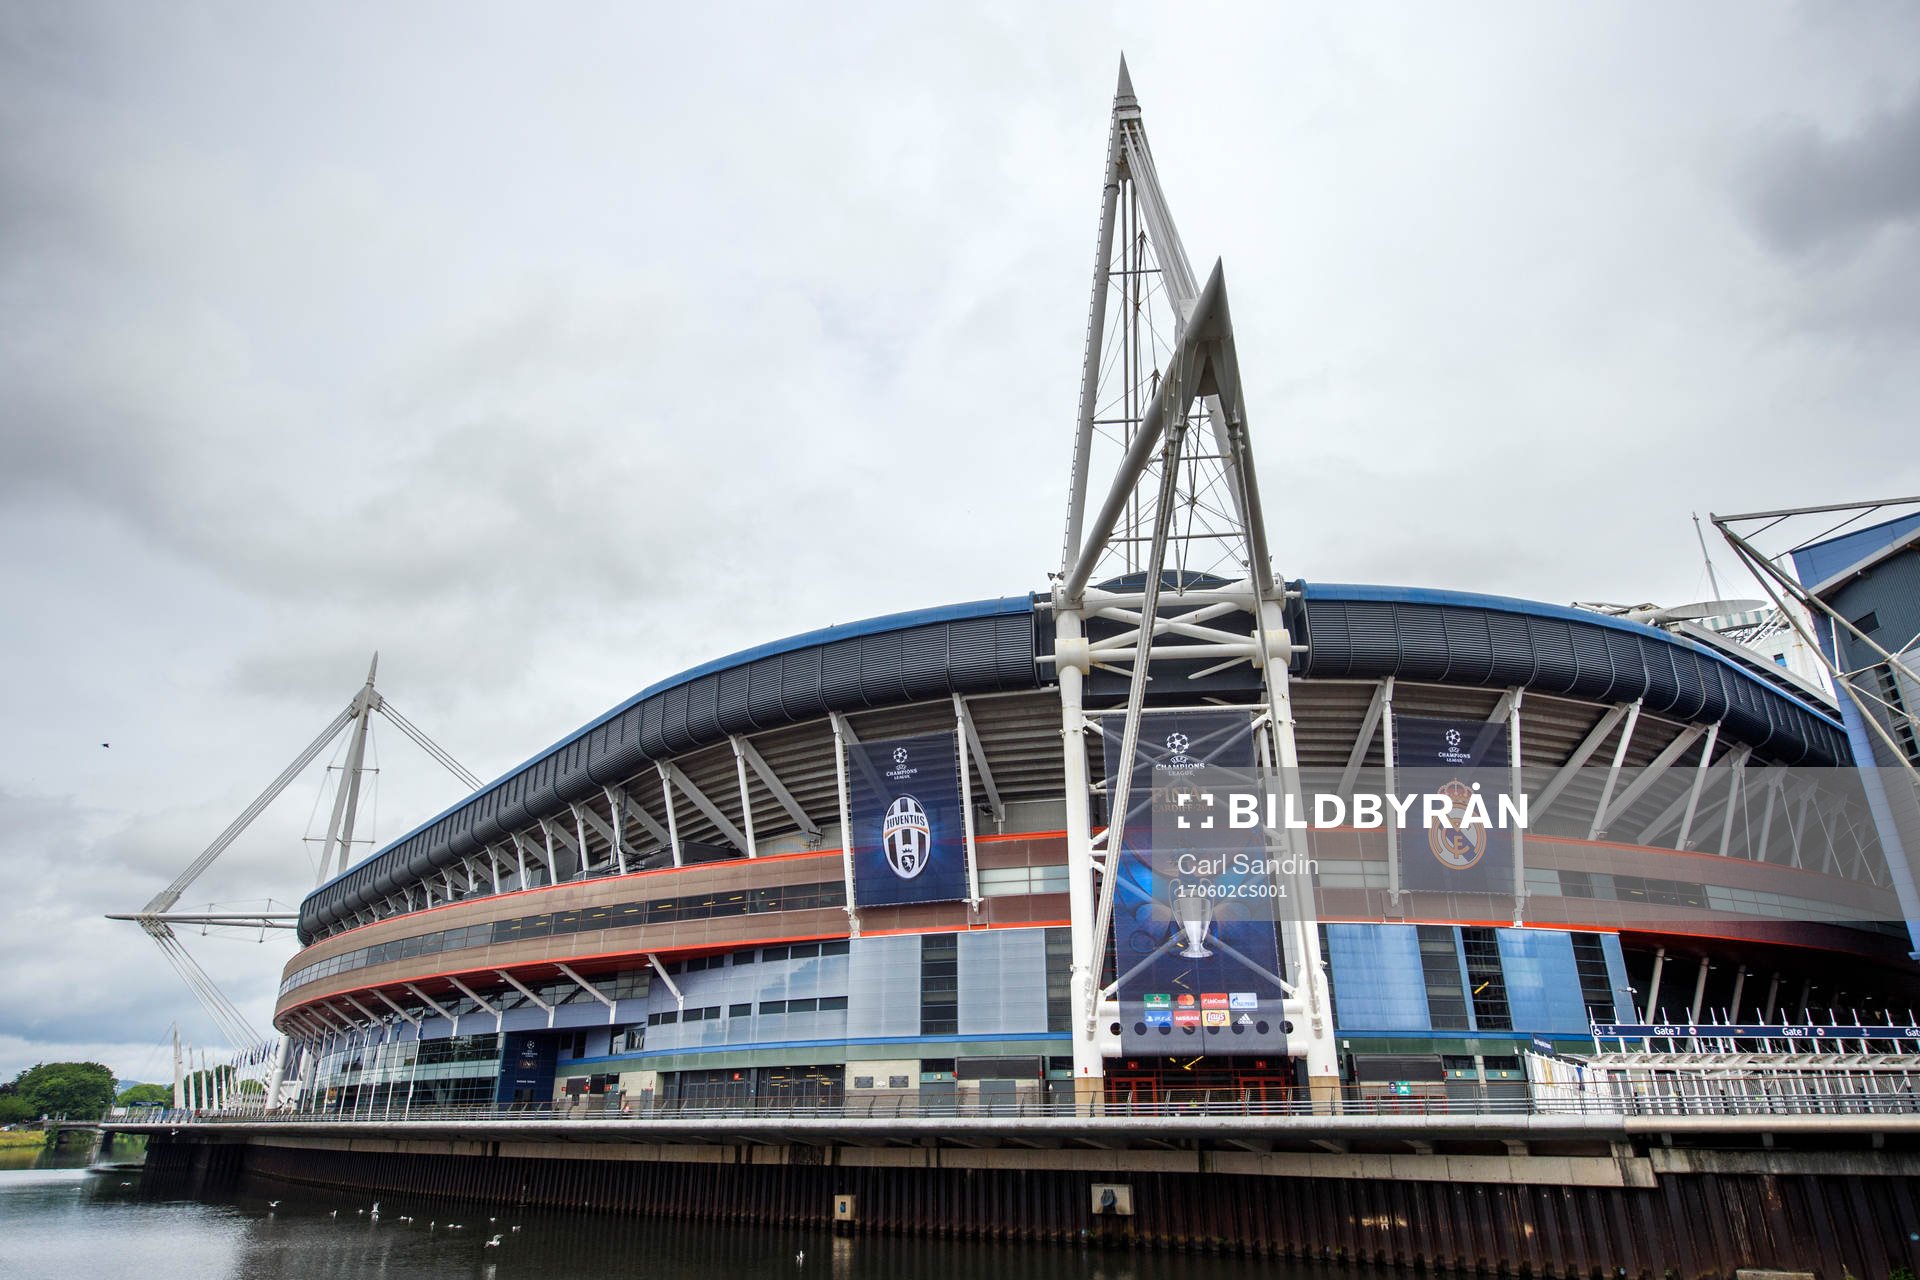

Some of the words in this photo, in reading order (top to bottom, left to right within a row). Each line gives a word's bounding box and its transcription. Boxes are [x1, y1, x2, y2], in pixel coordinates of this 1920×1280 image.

[1155, 762, 1206, 770] CHAMPIONS
[886, 768, 918, 776] CHAMPIONS
[887, 814, 925, 830] JUVENTUS
[1653, 1026, 1674, 1036] Gate
[1675, 1027, 1681, 1036] 7
[1782, 1027, 1802, 1036] Gate
[1802, 1027, 1809, 1036] 7
